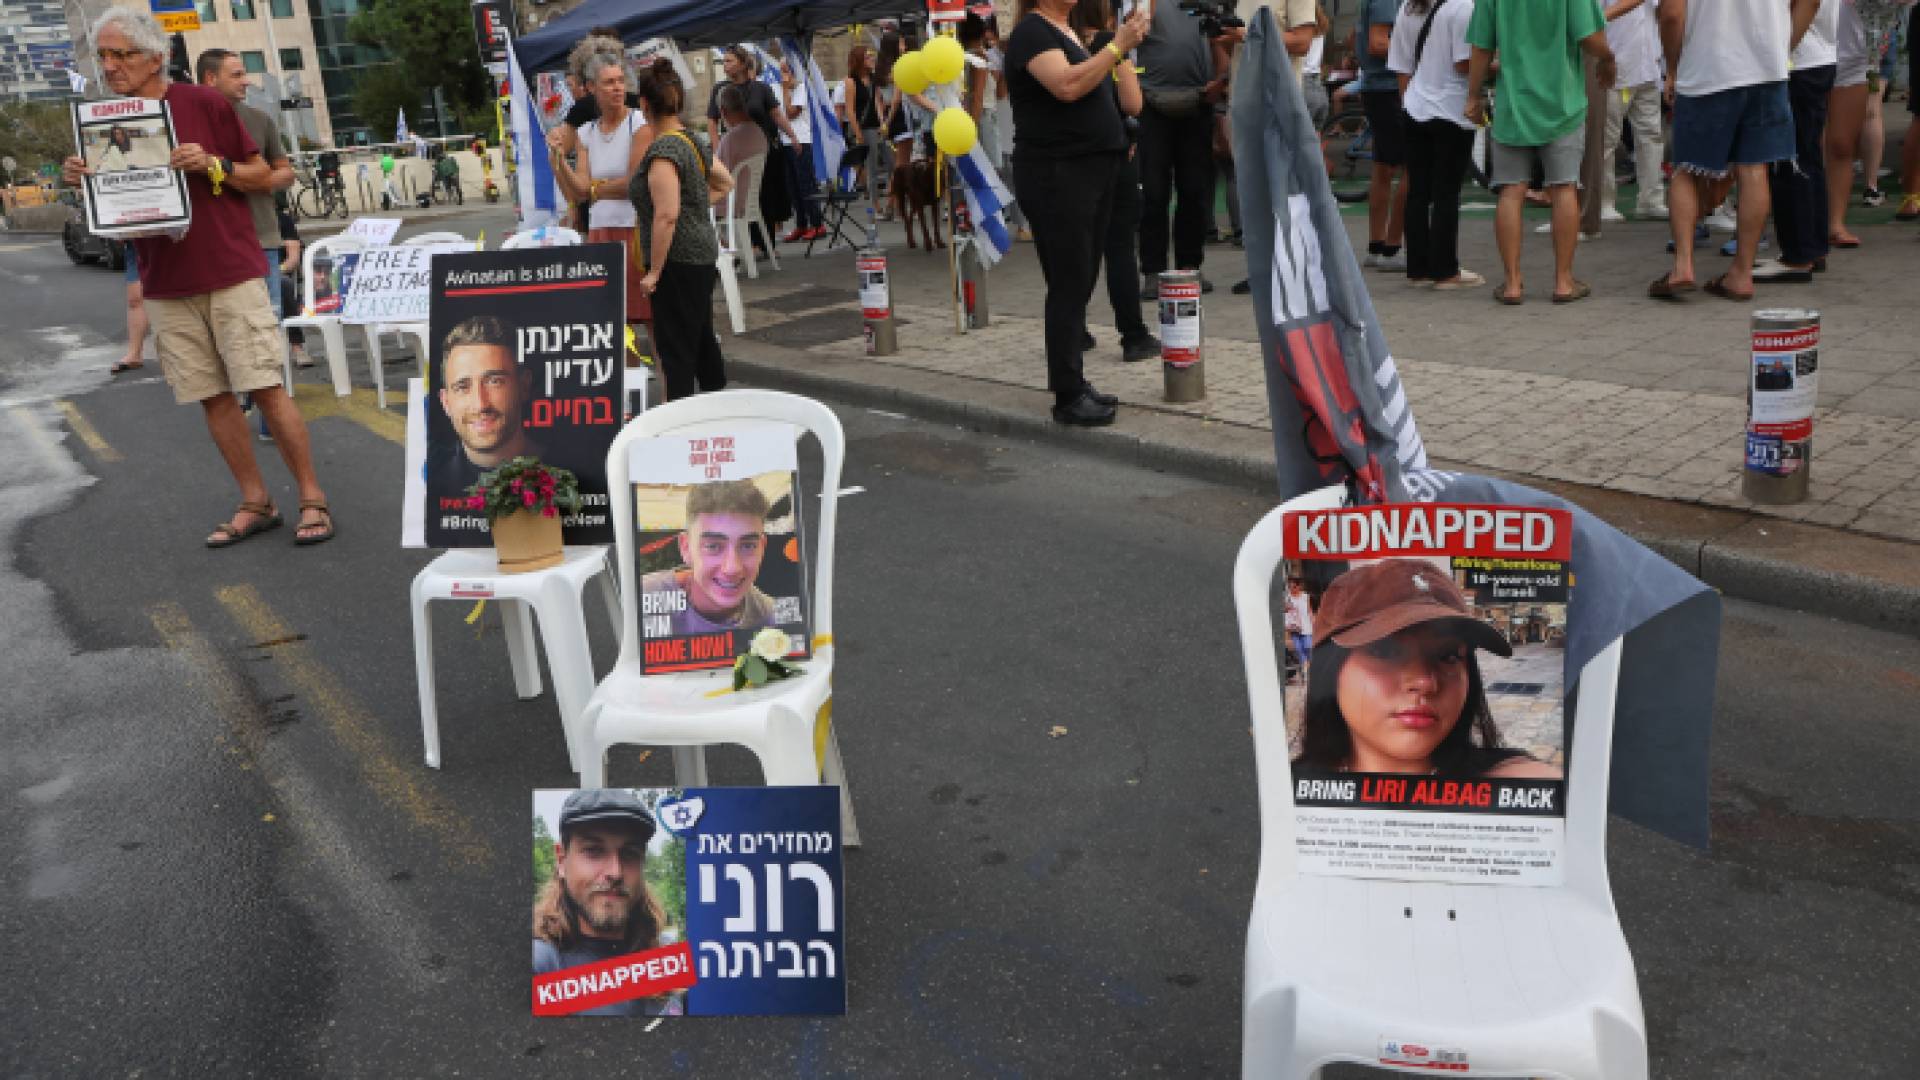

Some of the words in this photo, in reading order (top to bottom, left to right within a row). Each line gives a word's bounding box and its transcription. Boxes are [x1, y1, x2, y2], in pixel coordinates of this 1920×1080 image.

[362, 248, 424, 269] FREE
[445, 269, 515, 287] Avinatan
[519, 266, 533, 281] is
[536, 262, 563, 280] still
[566, 260, 609, 278] alive.
[353, 270, 431, 295] HOSTAG
[516, 321, 614, 364] אבינתן
[545, 357, 614, 398] עדיין
[522, 395, 614, 428] בחיים.
[1298, 507, 1556, 554] KIDNAPPED
[642, 590, 687, 614] BRING
[645, 639, 687, 664] HOME
[690, 631, 734, 660] NOW!
[1296, 779, 1357, 801] BRING
[1360, 776, 1407, 803] LIRI
[1410, 779, 1492, 808] ALBAG
[1498, 786, 1555, 809] BACK
[697, 832, 733, 854] את
[739, 832, 833, 854] מחזירים
[698, 861, 836, 932] רוני
[699, 941, 836, 978] הביתה
[537, 952, 690, 1006] KIDNAPPED!
